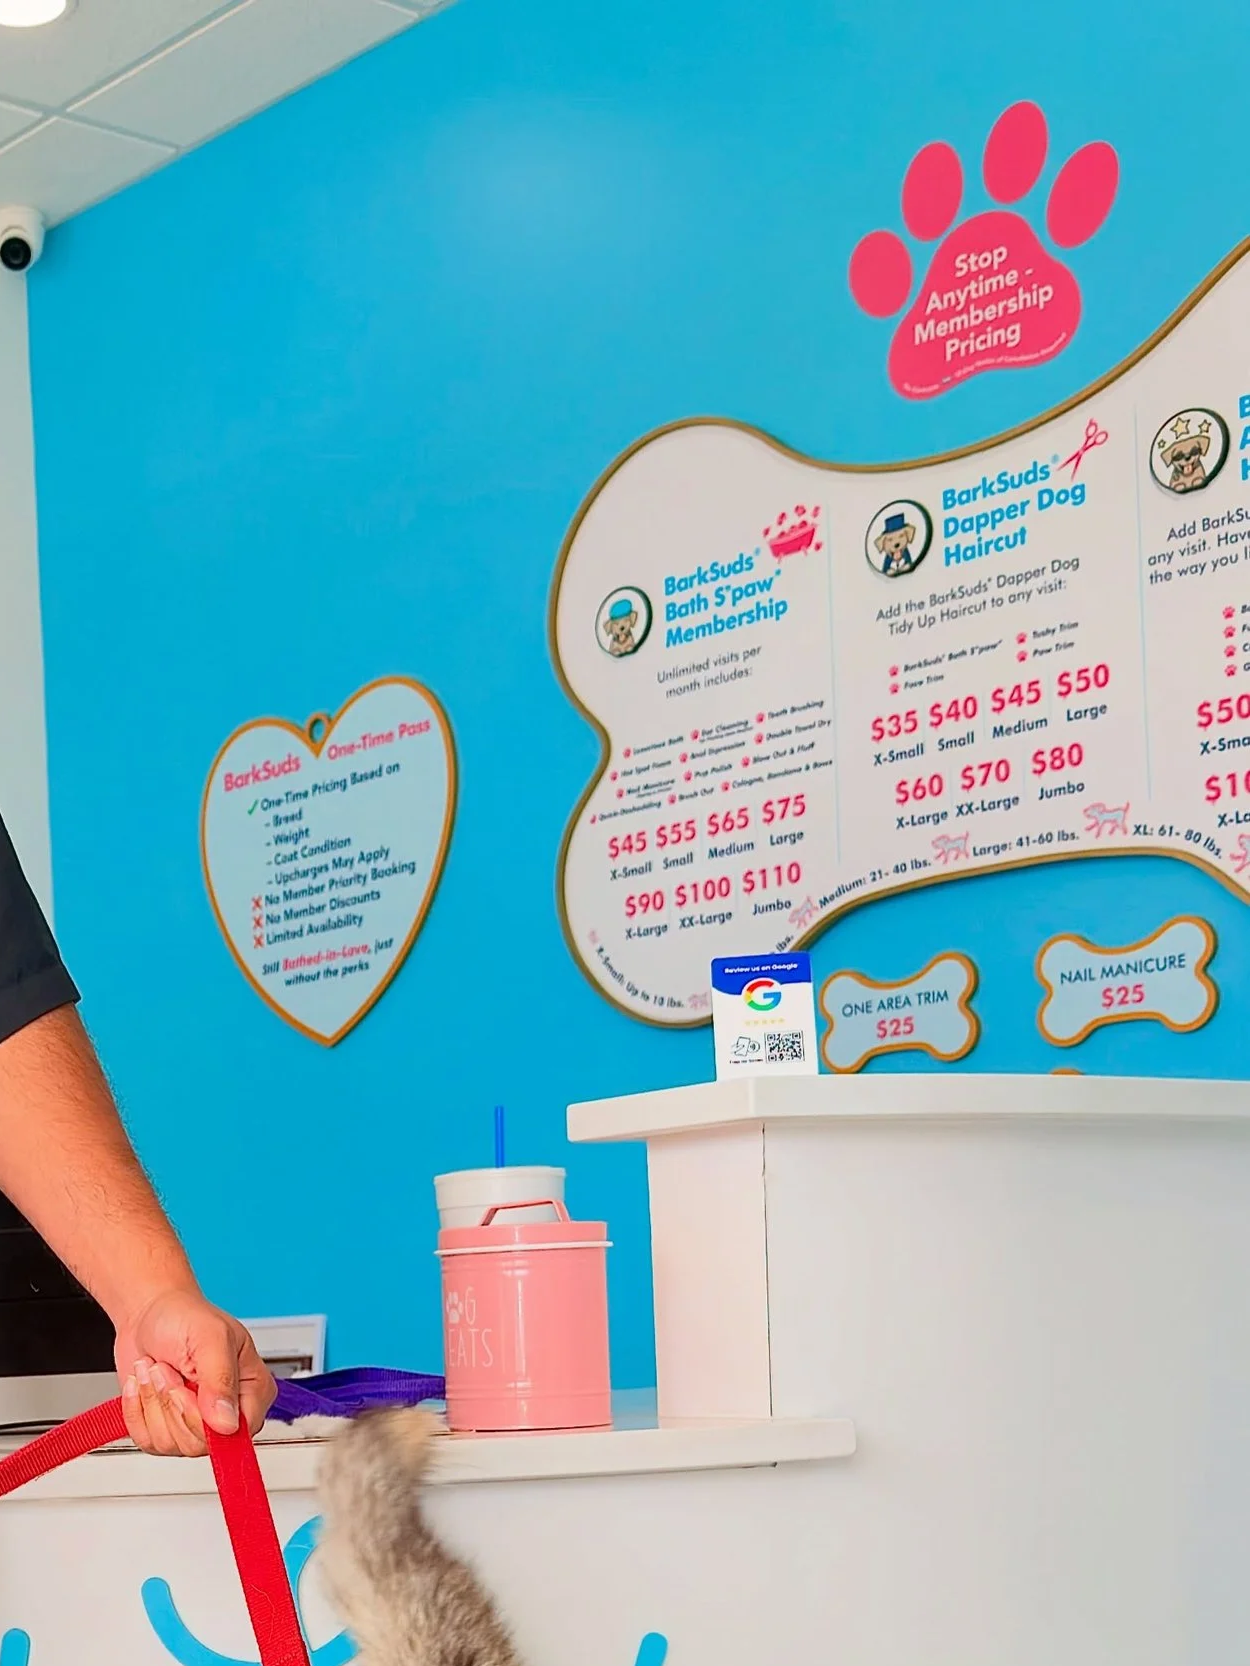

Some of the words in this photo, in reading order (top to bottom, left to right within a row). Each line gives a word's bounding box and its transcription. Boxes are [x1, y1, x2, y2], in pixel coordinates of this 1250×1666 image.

[955, 246, 1008, 277] Stop
[925, 269, 1018, 314] Anytime
[914, 284, 1053, 345] Membership
[945, 323, 1021, 361] Pricing
[943, 499, 1031, 539] Dapper
[1037, 483, 1086, 512] Dog
[944, 526, 1028, 567] Haircut
[1167, 520, 1196, 542] Add
[1148, 550, 1174, 566] any
[1149, 570, 1173, 585] the
[1177, 562, 1207, 576] way
[1211, 553, 1239, 572] you
[665, 593, 709, 622] Bath
[876, 602, 901, 621] Add
[905, 597, 925, 613] the
[996, 566, 1046, 590] Dapper
[1051, 557, 1080, 575] Dog
[888, 616, 914, 637] Tidy
[917, 615, 936, 631] Up
[940, 599, 987, 623] Haircut
[990, 595, 1005, 608] to
[1008, 588, 1033, 605] any
[1036, 578, 1067, 596] visit:
[666, 598, 788, 648] Membership
[657, 658, 709, 683] Unlimited
[713, 651, 740, 667] visits
[742, 645, 763, 663] per
[665, 679, 701, 699] month
[704, 667, 753, 688] includes:
[870, 709, 919, 744] $35
[929, 695, 978, 730] $40
[990, 679, 1042, 715] $45
[1056, 663, 1110, 699] $50
[1197, 694, 1250, 731] $50
[873, 743, 924, 767] X-Small
[937, 731, 975, 752] Small
[992, 717, 1048, 739] Medium
[1066, 703, 1108, 723] Large
[224, 753, 301, 792] BarkSuds
[327, 730, 394, 761] One-Time
[399, 719, 431, 740] Pass
[895, 773, 944, 807] $60
[960, 758, 1011, 793] $70
[1031, 742, 1084, 778] $80
[261, 790, 309, 811] One-Time
[312, 777, 347, 798] Pricing
[351, 768, 383, 786] Based
[386, 762, 400, 774] on
[896, 809, 948, 830] X-Large
[956, 794, 1020, 818] XX-Large
[1038, 781, 1085, 801] Jumbo
[273, 809, 303, 828] Breed
[273, 828, 310, 847] Weight
[608, 830, 647, 860] $45
[656, 819, 697, 849] $55
[707, 807, 750, 838] $65
[762, 793, 807, 825] $75
[274, 849, 299, 866] Coat
[300, 836, 351, 860] Condition
[610, 861, 653, 881] X-Small
[662, 852, 694, 871] Small
[708, 842, 755, 860] Medium
[769, 830, 805, 848] Large
[972, 841, 1012, 857] Large:
[1016, 831, 1054, 848] 41-60
[1057, 830, 1079, 842] lbs.
[1133, 823, 1153, 836] XL:
[1185, 829, 1202, 844] 80
[1203, 836, 1222, 860] lbs.
[265, 893, 280, 907] No
[282, 882, 325, 903] Member
[329, 870, 367, 892] Priority
[370, 860, 416, 881] Booking
[275, 860, 329, 887] Upcharges
[332, 854, 354, 872] May
[357, 845, 390, 866] Apply
[819, 876, 867, 908] Medium:
[892, 862, 907, 875] 40
[910, 857, 931, 870] lbs.
[265, 913, 280, 926] No
[283, 901, 326, 922] Member
[329, 888, 381, 912] Discounts
[625, 889, 665, 919] $90
[674, 876, 731, 908] $100
[742, 861, 802, 894] $110
[266, 926, 304, 945] Limited
[306, 913, 364, 938] Availability
[625, 922, 669, 941] X-Large
[679, 911, 733, 931] XX-Large
[752, 898, 792, 916] Jumbo
[262, 962, 280, 976] Still
[374, 937, 394, 955] just
[284, 968, 320, 987] without
[323, 965, 339, 980] the
[341, 959, 370, 979] perks
[724, 966, 750, 974] Review
[772, 962, 798, 972] Google
[1059, 966, 1095, 986] NAIL
[1100, 952, 1187, 981] MANICURE
[626, 981, 639, 997] Up
[640, 990, 650, 1002] to
[667, 997, 685, 1008] lbs.
[842, 1000, 874, 1018] ONE
[877, 994, 913, 1013] AREA
[916, 988, 949, 1007] TRIM
[1100, 983, 1146, 1010] $25
[876, 1014, 915, 1041] $25
[447, 1327, 493, 1368] EATS
